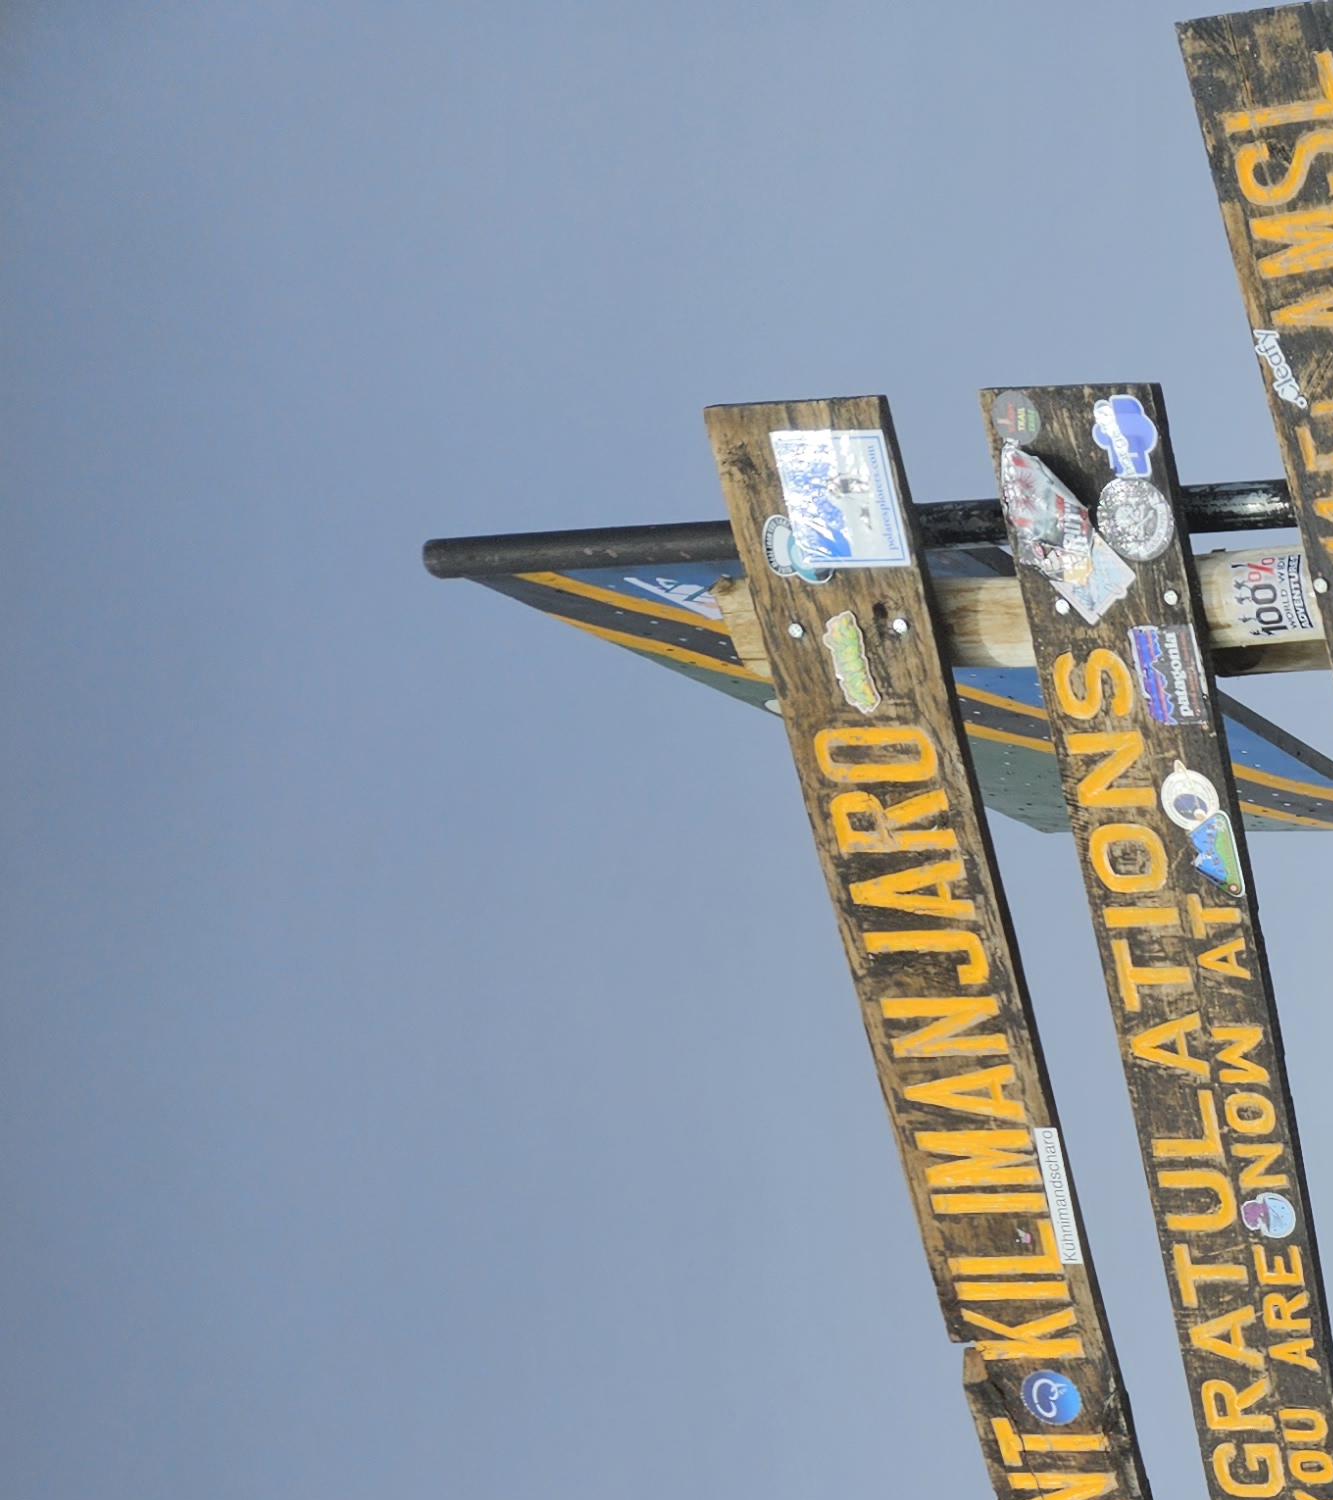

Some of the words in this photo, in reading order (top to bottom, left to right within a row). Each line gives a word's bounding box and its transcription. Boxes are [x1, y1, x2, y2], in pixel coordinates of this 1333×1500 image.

[1255, 331, 1299, 400] Cleafy
[866, 445, 898, 550] polarexplorers.com
[1247, 557, 1288, 636] 100%
[1281, 589, 1297, 629] WORLD
[1165, 632, 1194, 717] patagonia
[1187, 894, 1252, 980] AT
[814, 726, 1085, 1360] KILIMANJARO
[1211, 1025, 1290, 1188] NOW
[1042, 1130, 1077, 1261] Kühnimandscharo
[1252, 1244, 1321, 1371] ARE
